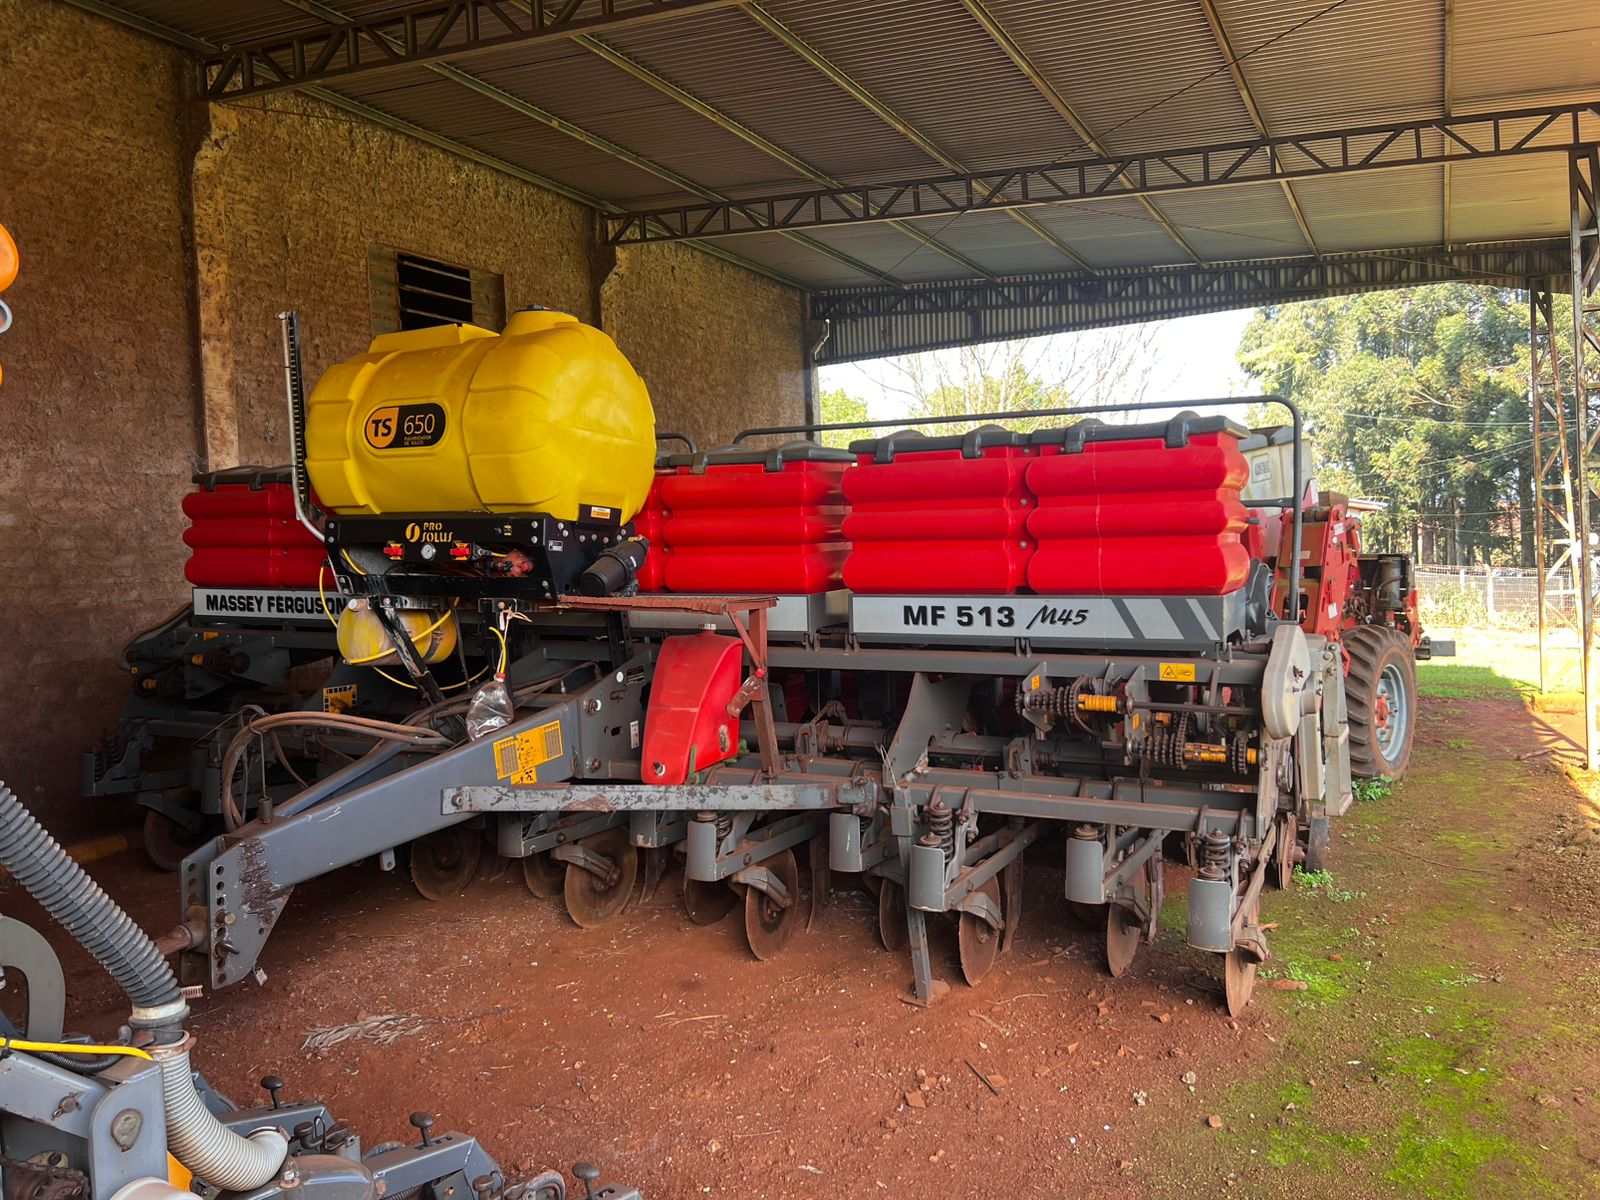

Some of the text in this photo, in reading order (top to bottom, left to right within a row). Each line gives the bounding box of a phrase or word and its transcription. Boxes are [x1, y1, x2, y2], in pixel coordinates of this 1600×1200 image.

[371, 413, 435, 437] TS 650
[423, 522, 442, 530] PRO
[421, 532, 453, 542] SOLUS
[206, 594, 347, 614] MASSEY FERGUSON
[903, 604, 1089, 630] MF 513 M45
